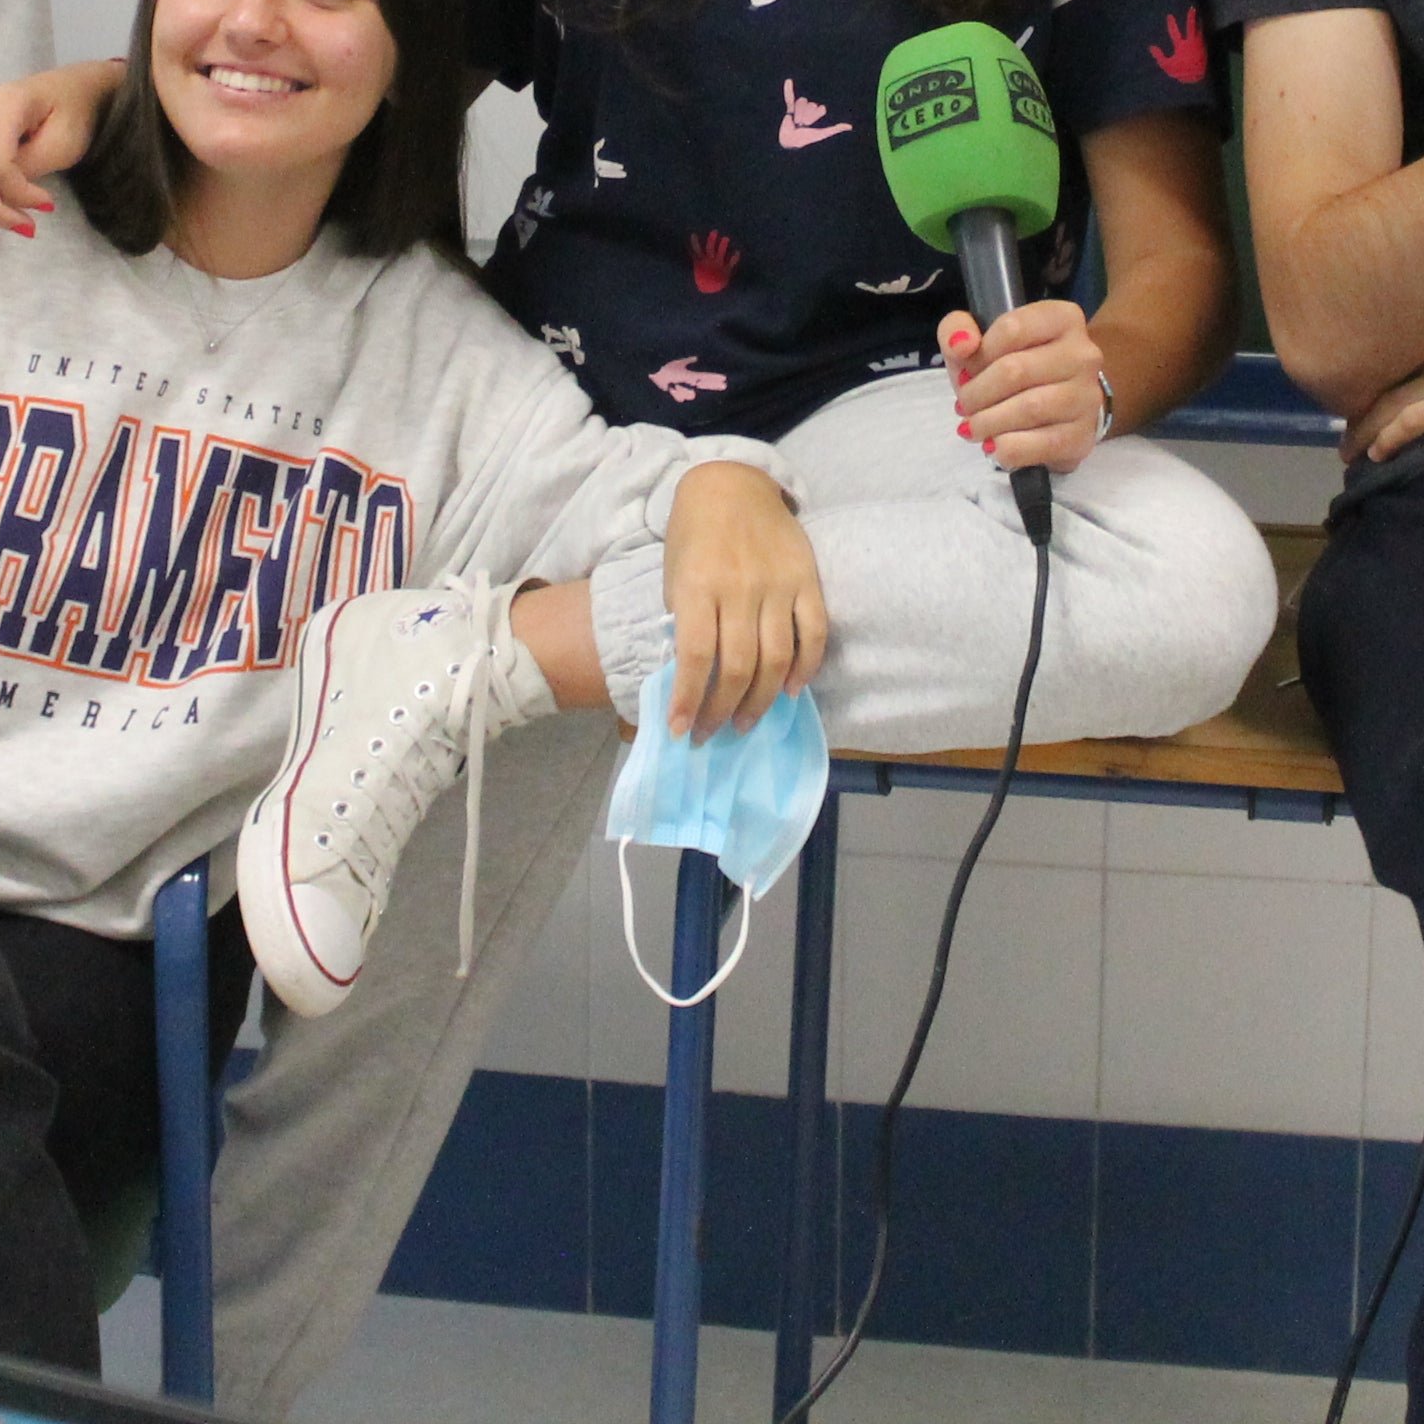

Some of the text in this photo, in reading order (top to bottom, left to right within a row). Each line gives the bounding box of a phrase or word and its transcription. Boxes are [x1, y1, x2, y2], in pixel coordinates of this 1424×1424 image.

[893, 74, 960, 106] ONDA
[900, 98, 962, 131] CERO
[27, 353, 324, 437] UNITED STATES
